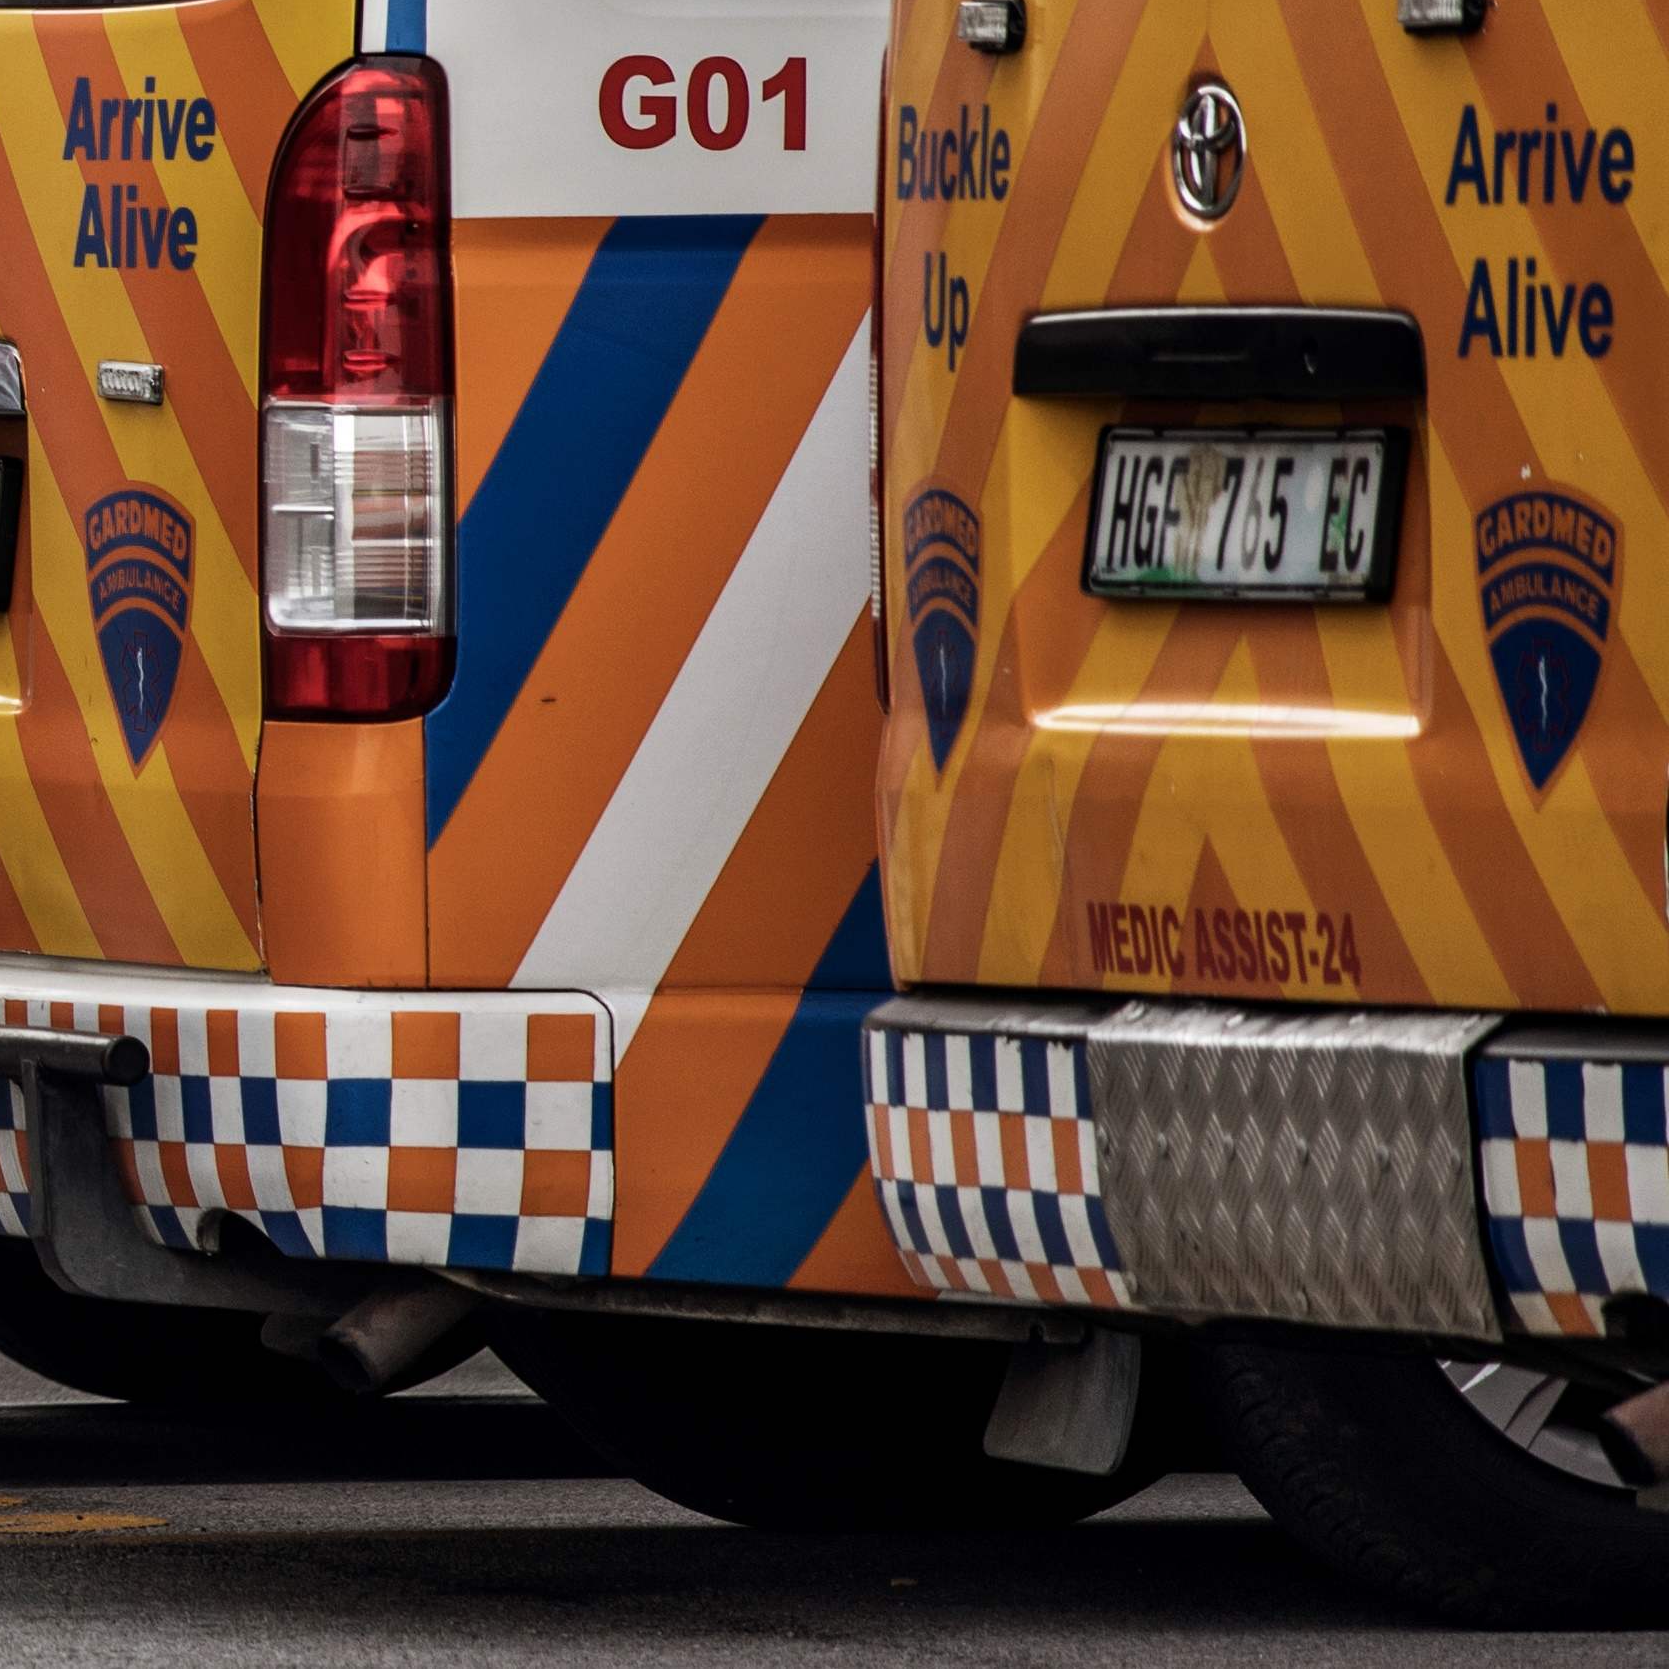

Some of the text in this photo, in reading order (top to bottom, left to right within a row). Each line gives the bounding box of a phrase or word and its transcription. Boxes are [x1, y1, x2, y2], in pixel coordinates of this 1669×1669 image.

[63, 76, 216, 161] Arrive
[598, 54, 809, 152] G01
[896, 104, 1011, 201] Buckle
[1445, 104, 1635, 205] Arrive
[74, 184, 198, 270] Alive
[923, 252, 969, 373] Up
[1458, 258, 1615, 360] Alive
[88, 499, 187, 560] GARDMED
[1216, 456, 1295, 572] 765
[1318, 456, 1370, 572] EC
[1479, 500, 1612, 567] GARDMED
[99, 566, 181, 612] AMBULANCE
[1490, 570, 1600, 620] AMBULANCE
[1086, 901, 1361, 986] MEDIC ASSIST-24
